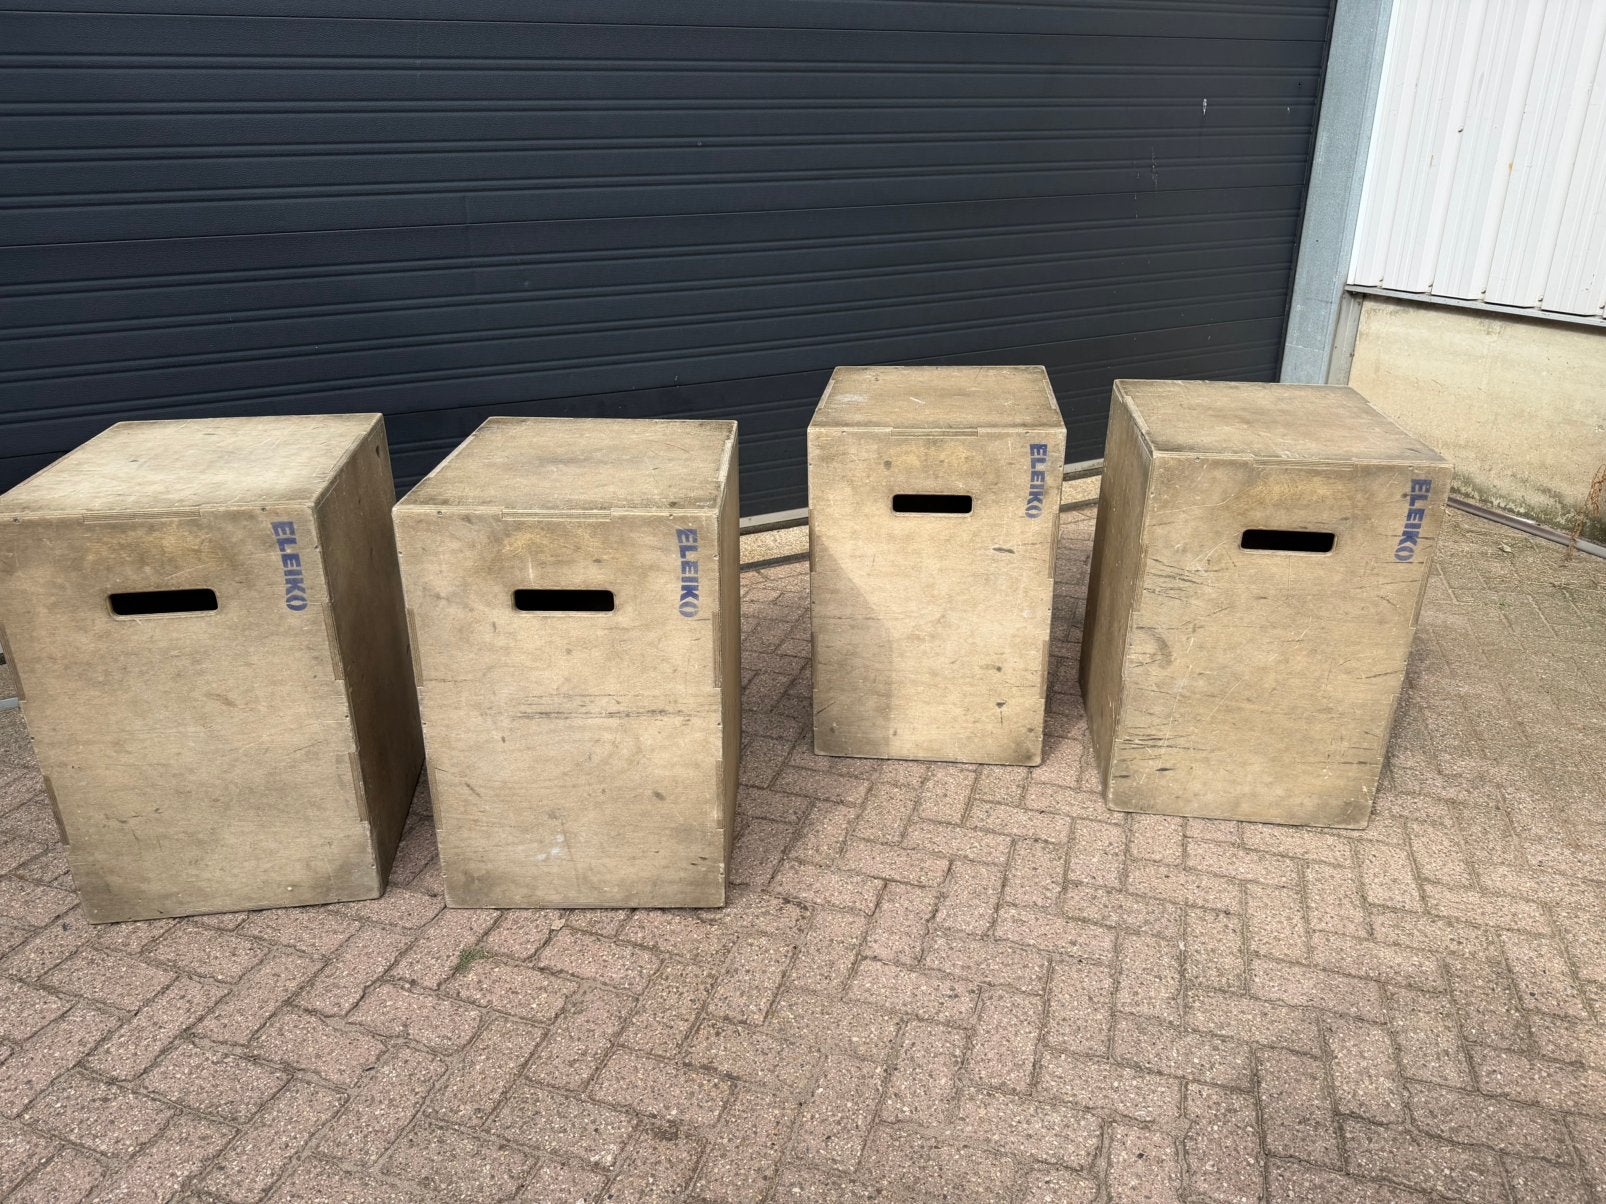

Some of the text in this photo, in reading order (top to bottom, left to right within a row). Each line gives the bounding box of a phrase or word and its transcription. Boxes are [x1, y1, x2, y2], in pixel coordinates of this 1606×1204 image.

[1025, 444, 1048, 519] ELEIKO
[1394, 479, 1431, 562] ELEIKO
[271, 522, 308, 612] ELEIKO
[676, 529, 699, 618] ELEIKO
